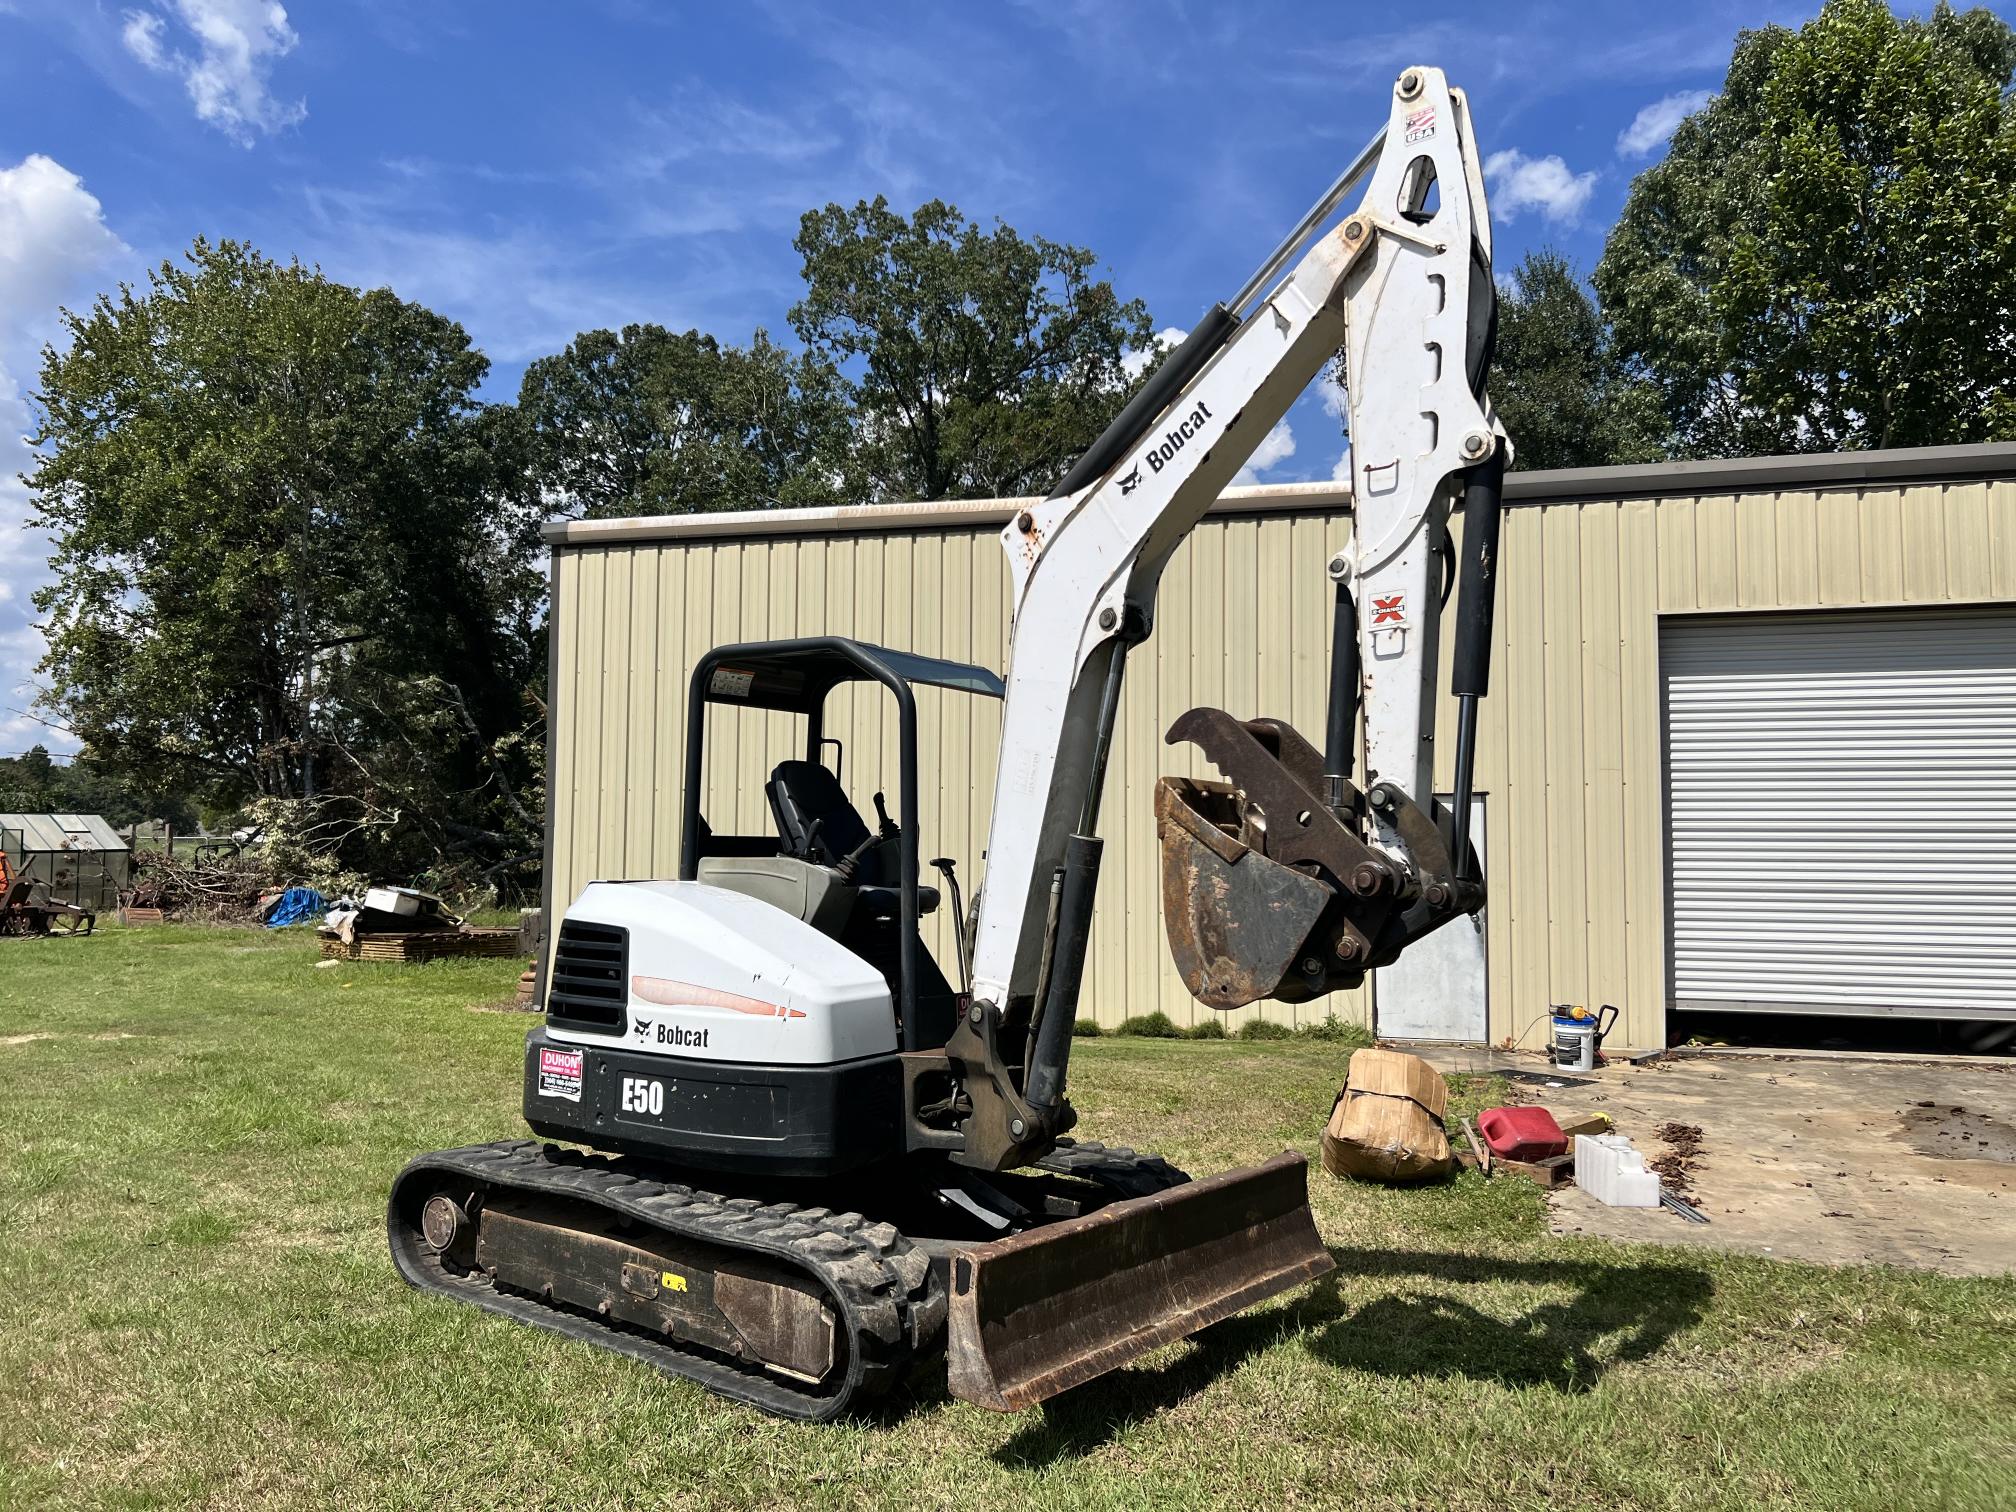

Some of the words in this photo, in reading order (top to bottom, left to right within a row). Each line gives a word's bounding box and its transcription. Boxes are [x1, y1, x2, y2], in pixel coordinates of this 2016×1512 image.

[1407, 128, 1433, 142] USA
[1145, 401, 1212, 474] Bobcat
[657, 1024, 709, 1048] Bobcat
[545, 1052, 578, 1069] DUHON
[622, 1078, 664, 1115] E50
